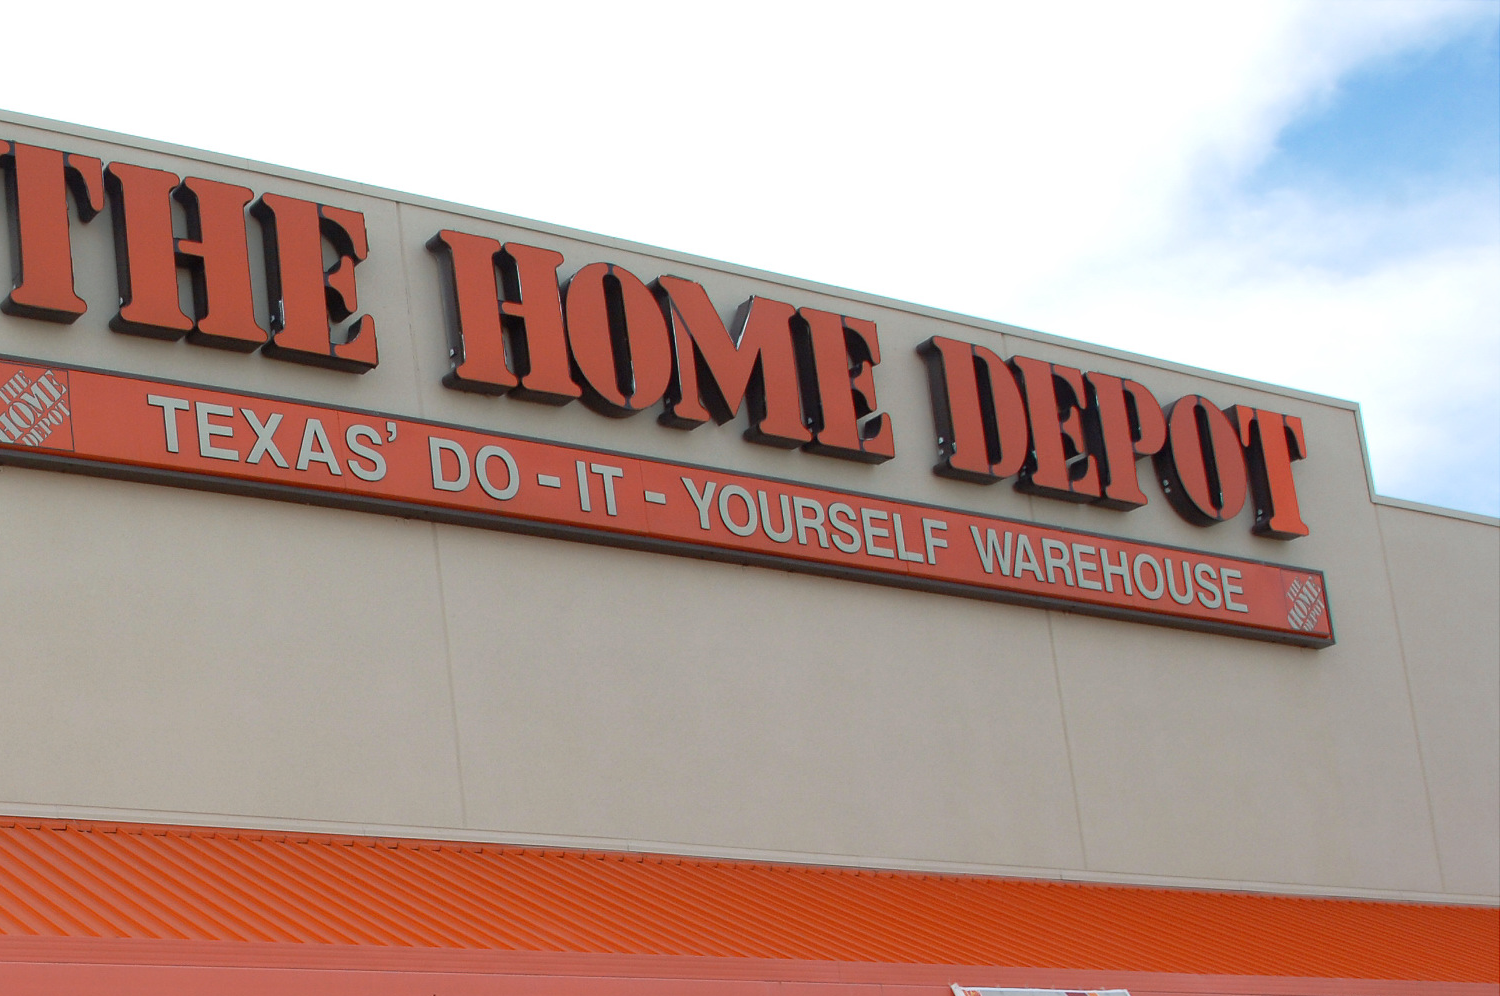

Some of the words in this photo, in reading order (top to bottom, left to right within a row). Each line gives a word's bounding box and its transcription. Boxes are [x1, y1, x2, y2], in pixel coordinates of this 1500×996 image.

[21, 399, 71, 446] DEPOT
[427, 229, 895, 464] HOME
[918, 335, 1310, 540] DEPOT
[147, 393, 397, 482] TEXAS'
[680, 477, 949, 565] YOURSELF
[970, 525, 1249, 613] WAREHOUSE
